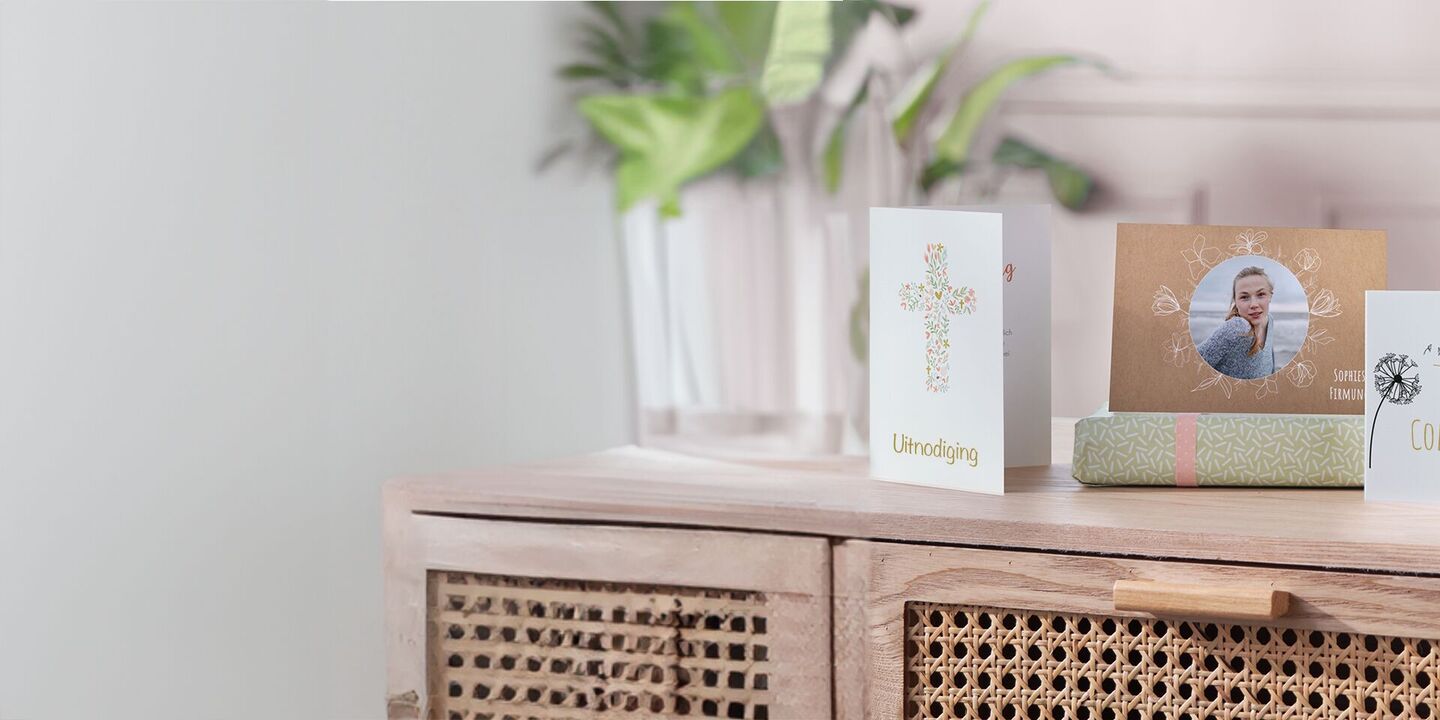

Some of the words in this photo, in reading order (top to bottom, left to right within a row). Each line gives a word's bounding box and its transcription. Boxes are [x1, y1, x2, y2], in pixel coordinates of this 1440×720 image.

[1333, 368, 1365, 382] SOPHIES
[1329, 386, 1364, 400] FIRMUN
[893, 432, 978, 467] Uitnodiging
